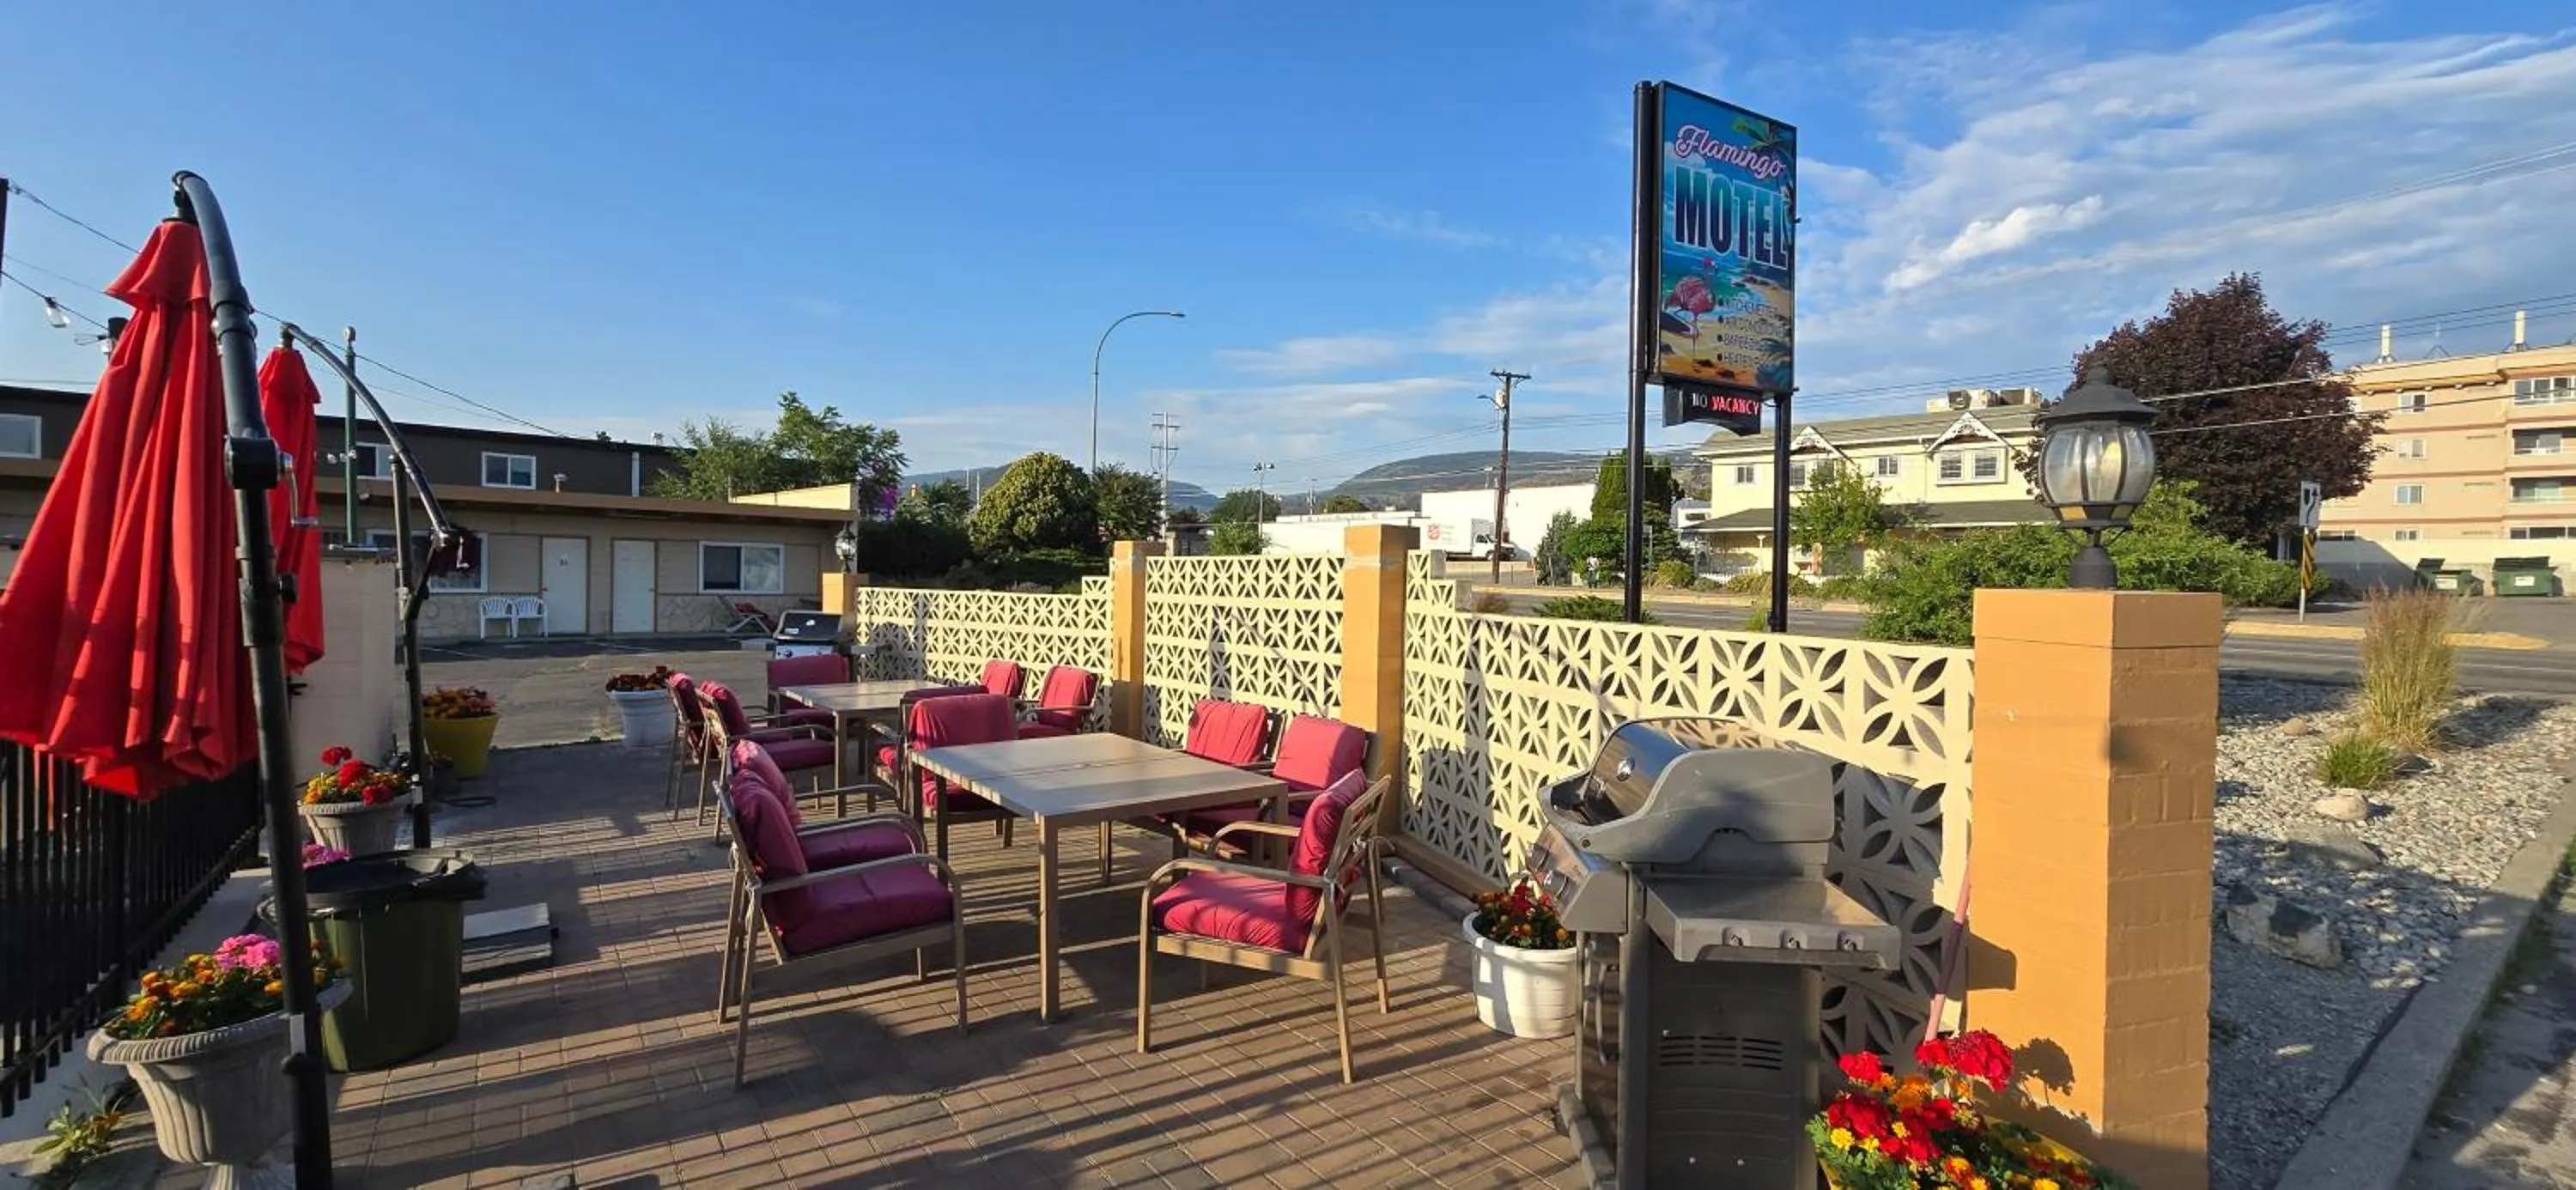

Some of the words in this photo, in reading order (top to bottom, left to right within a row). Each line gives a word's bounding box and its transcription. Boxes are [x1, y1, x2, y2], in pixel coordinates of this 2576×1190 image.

[1675, 124, 1787, 179] Flamingo
[1674, 164, 1789, 270] MOTEL
[1691, 392, 1708, 409] NO
[1711, 395, 1759, 416] VACANCY
